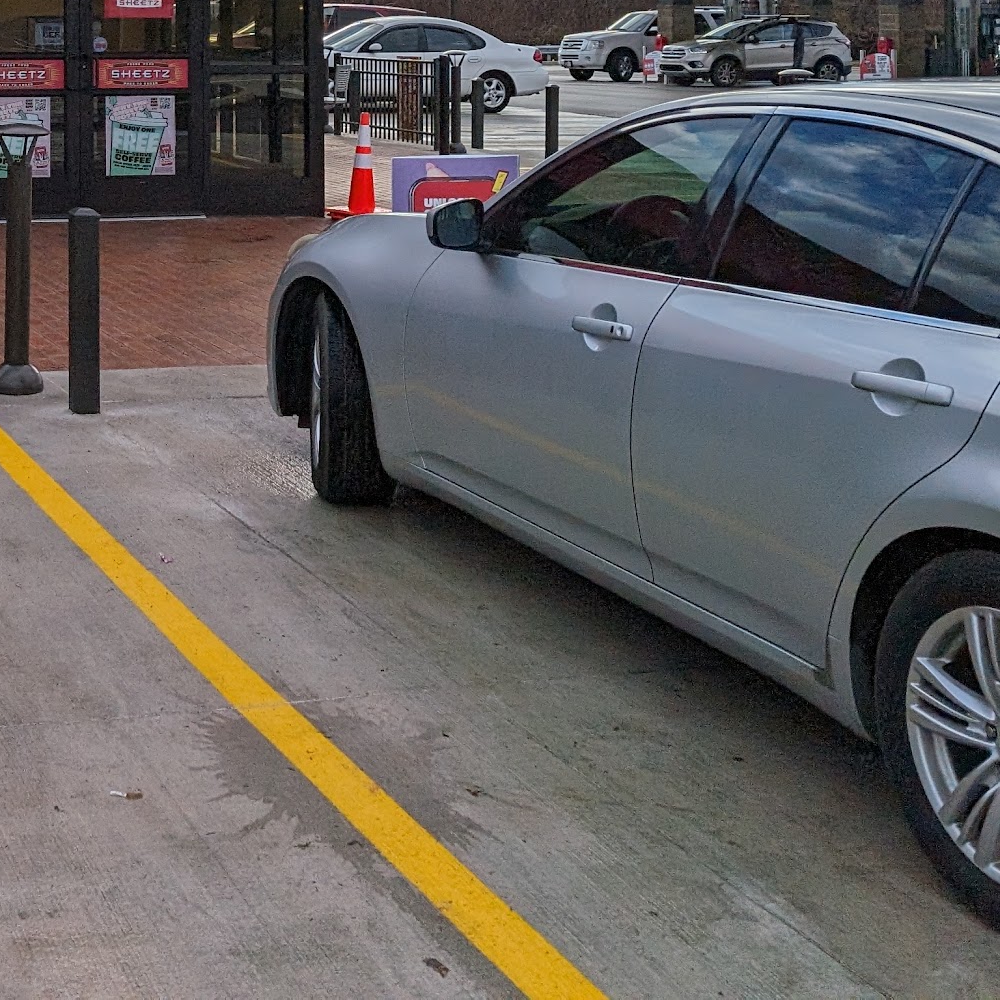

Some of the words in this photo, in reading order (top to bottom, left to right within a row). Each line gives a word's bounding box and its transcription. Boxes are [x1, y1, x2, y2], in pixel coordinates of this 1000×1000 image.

[111, 69, 170, 79] SHEETZ
[119, 123, 141, 132] ENJOY
[113, 129, 160, 153] FREE
[115, 154, 151, 164] COFFEE
